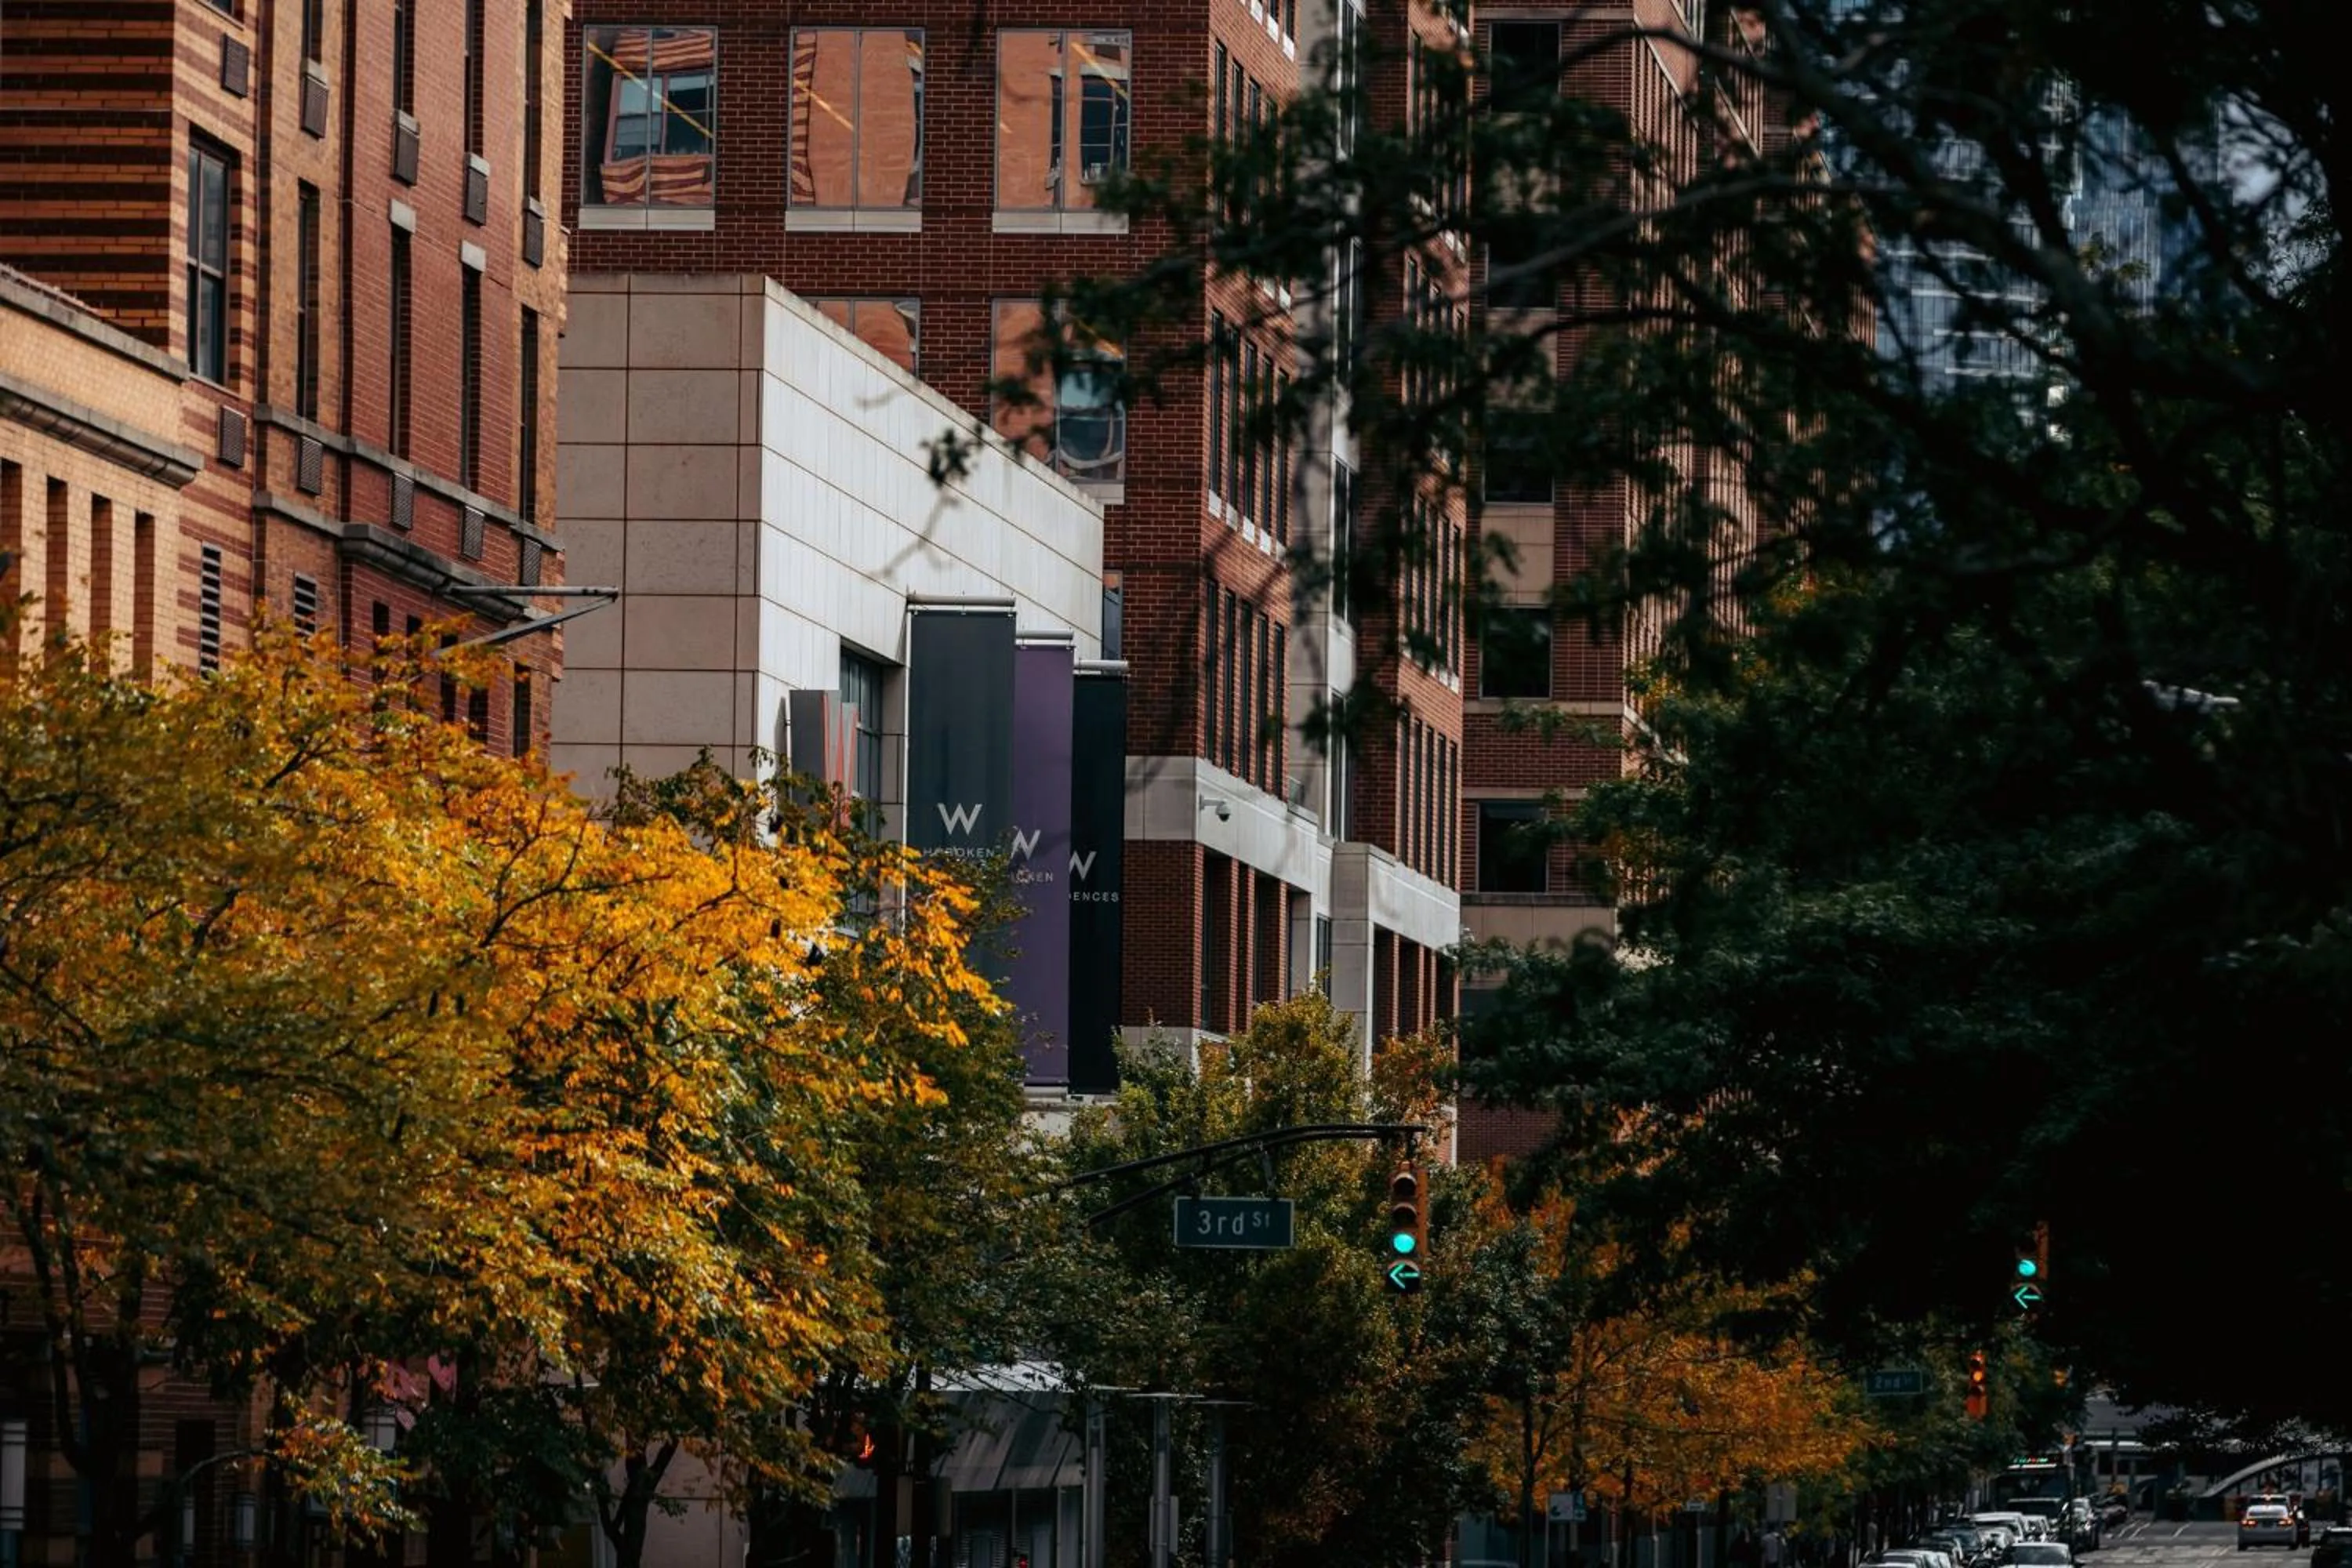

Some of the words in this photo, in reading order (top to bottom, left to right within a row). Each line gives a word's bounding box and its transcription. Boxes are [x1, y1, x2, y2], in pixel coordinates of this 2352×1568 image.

[937, 803, 983, 835] W
[1069, 891, 1120, 902] ENCES
[1197, 1210, 1244, 1236] 3rd
[1252, 1210, 1270, 1229] St
